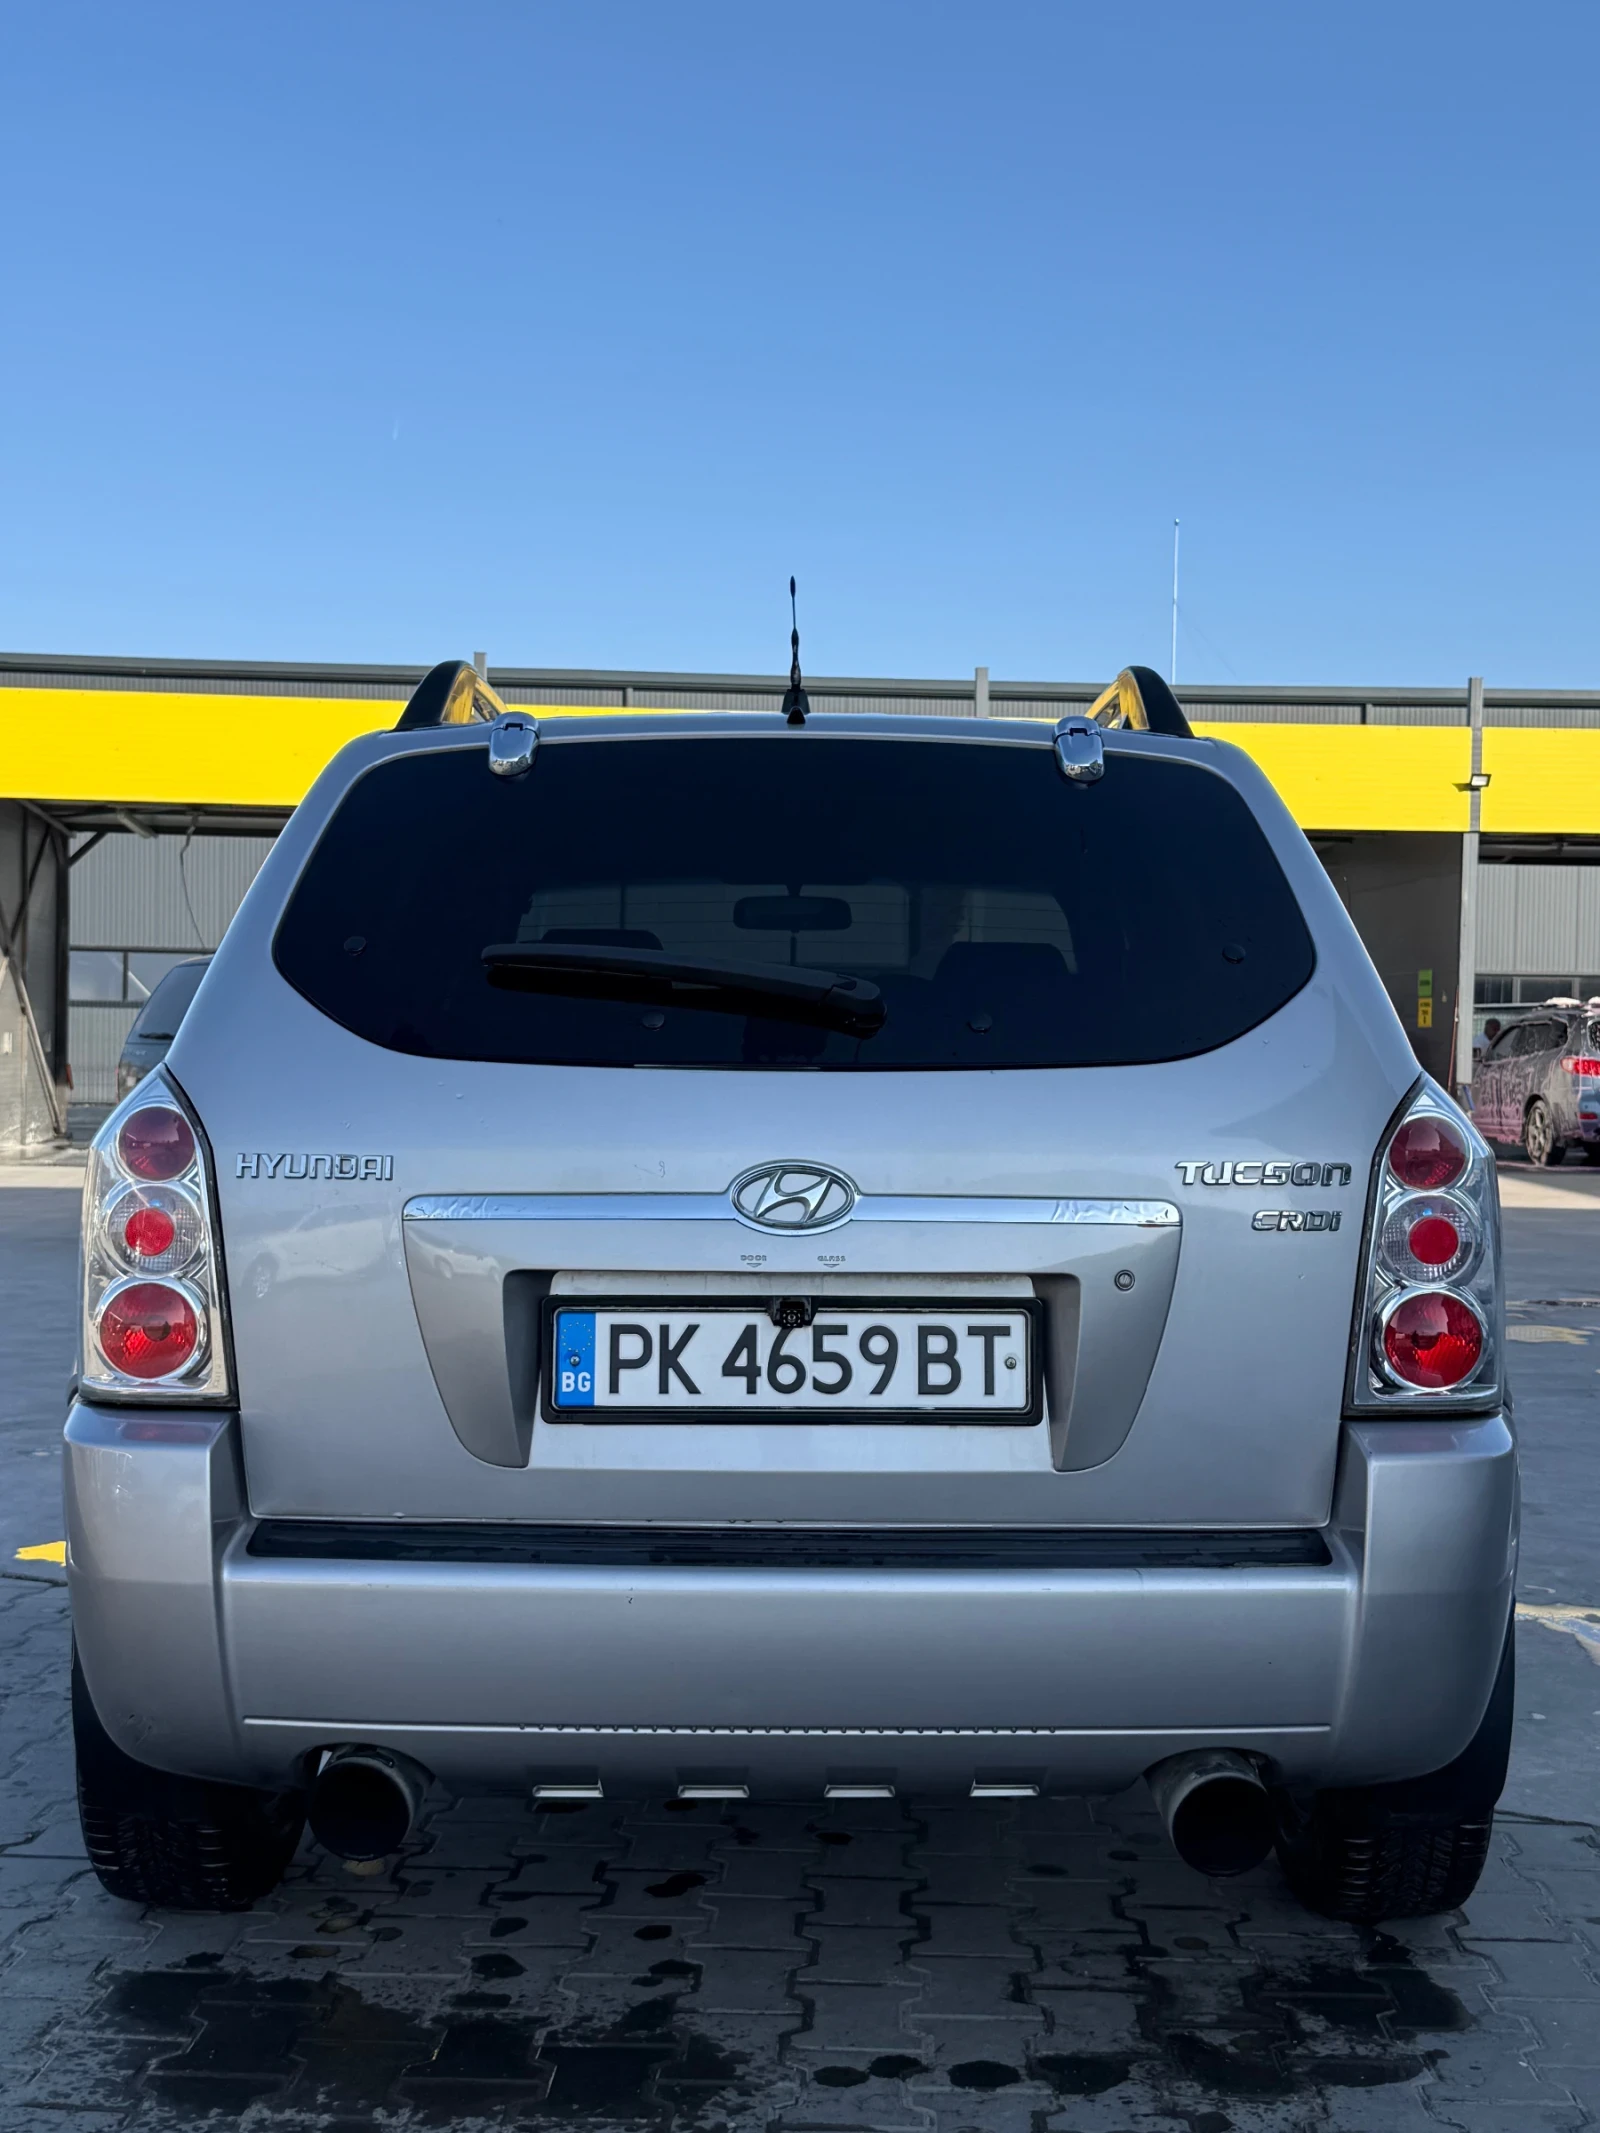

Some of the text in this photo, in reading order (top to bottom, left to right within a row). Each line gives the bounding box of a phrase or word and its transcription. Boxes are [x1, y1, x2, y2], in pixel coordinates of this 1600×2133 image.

[236, 1153, 393, 1180] HYUNDAI
[609, 1323, 1011, 1396] PK 4659 BT
[561, 1371, 591, 1392] BG
